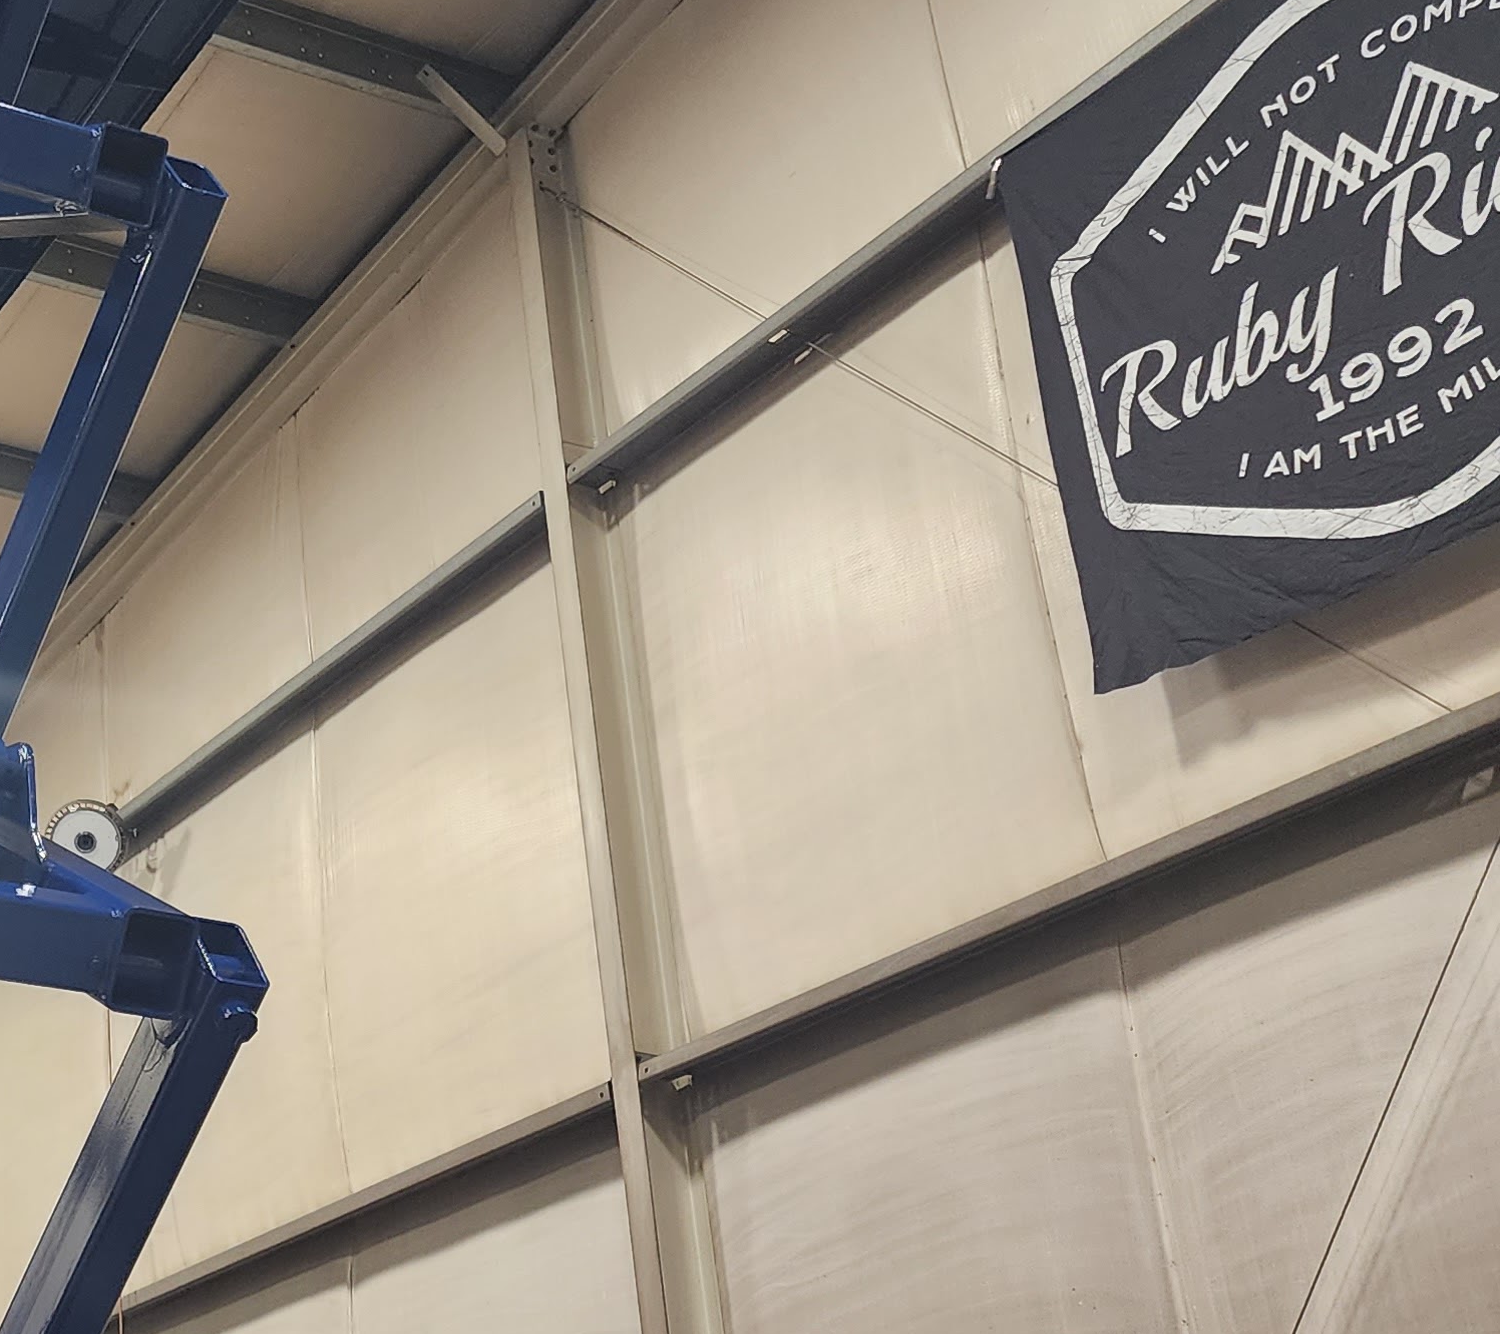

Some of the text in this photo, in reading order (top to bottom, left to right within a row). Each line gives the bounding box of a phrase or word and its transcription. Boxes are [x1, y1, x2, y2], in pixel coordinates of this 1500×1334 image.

[1148, 228, 1167, 244] I
[1165, 136, 1250, 212] WILL
[1260, 53, 1341, 129] NOT
[1100, 126, 1500, 458] Ruby Ri
[1307, 298, 1484, 423] 1992
[1238, 452, 1250, 478] I
[1263, 443, 1322, 479] AM
[1339, 404, 1425, 460] THE
